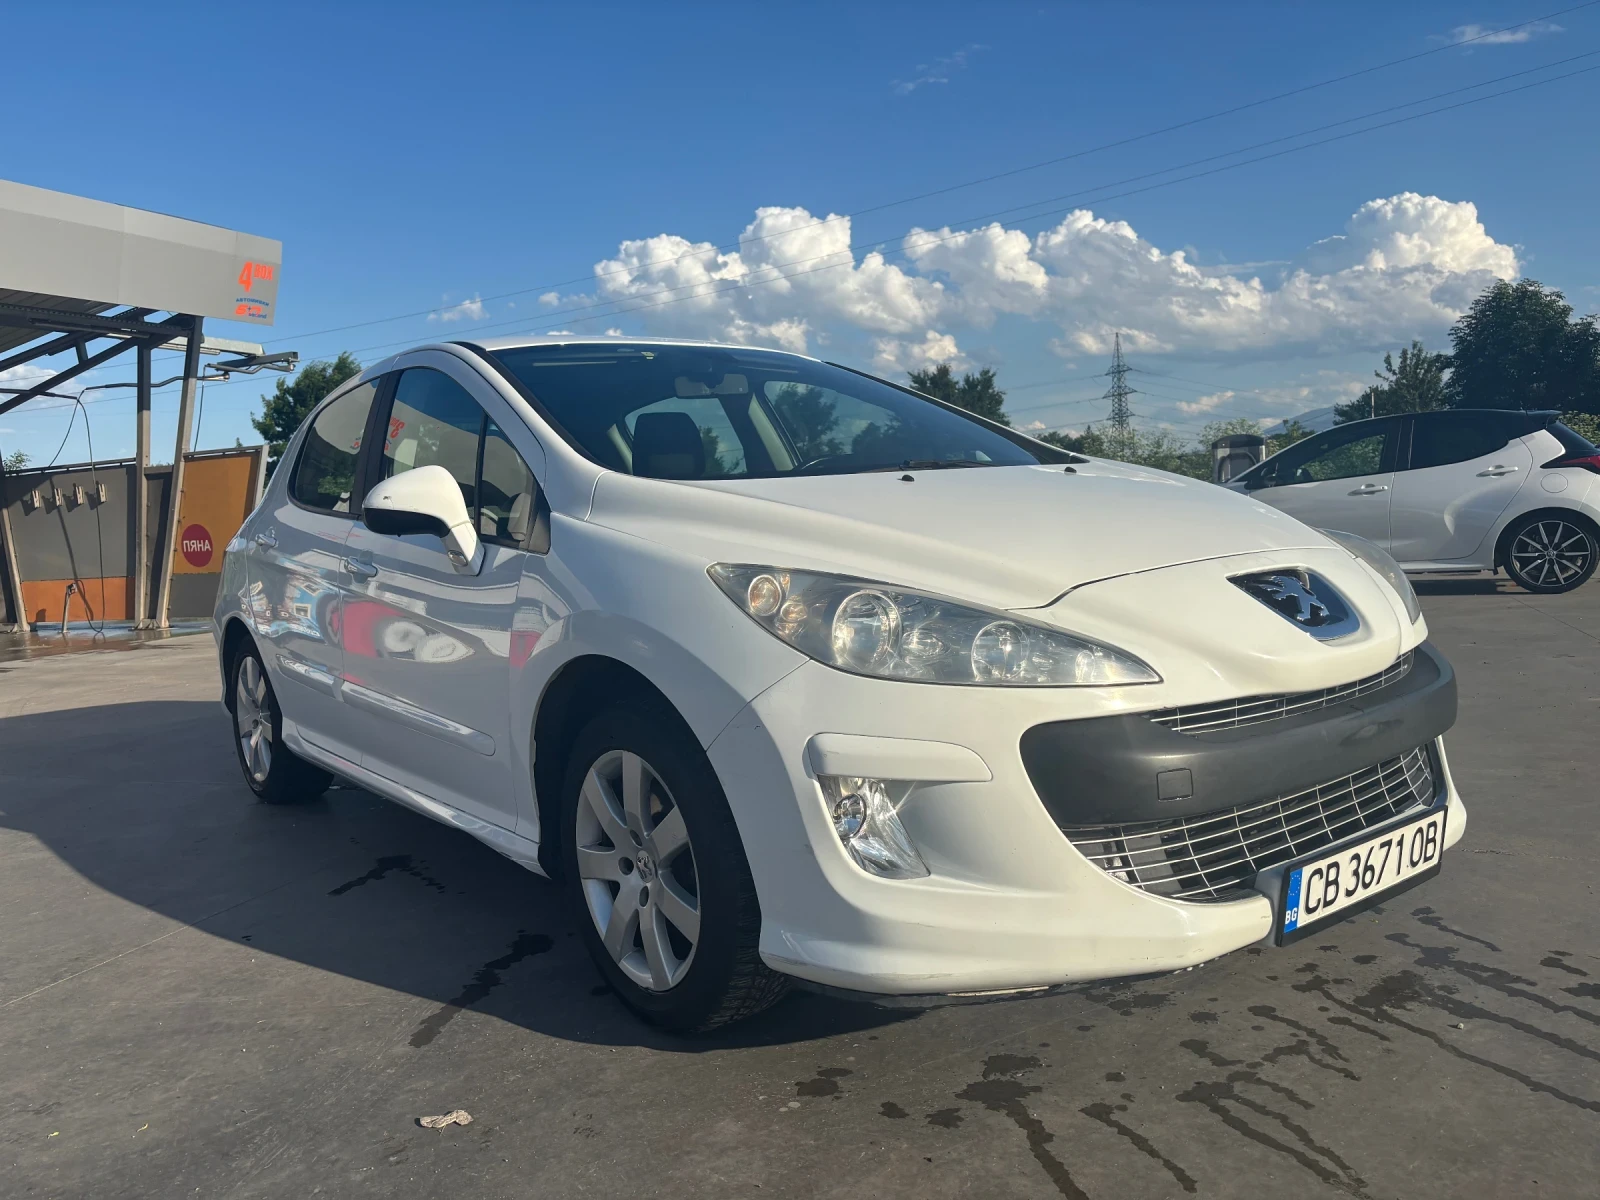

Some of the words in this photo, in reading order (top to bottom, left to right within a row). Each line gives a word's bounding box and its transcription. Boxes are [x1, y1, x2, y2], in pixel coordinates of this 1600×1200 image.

[238, 261, 252, 292] 4
[183, 540, 211, 552] ПЯНА
[1304, 861, 1340, 915] CB
[1344, 833, 1404, 898] 3671
[1285, 907, 1298, 924] BG
